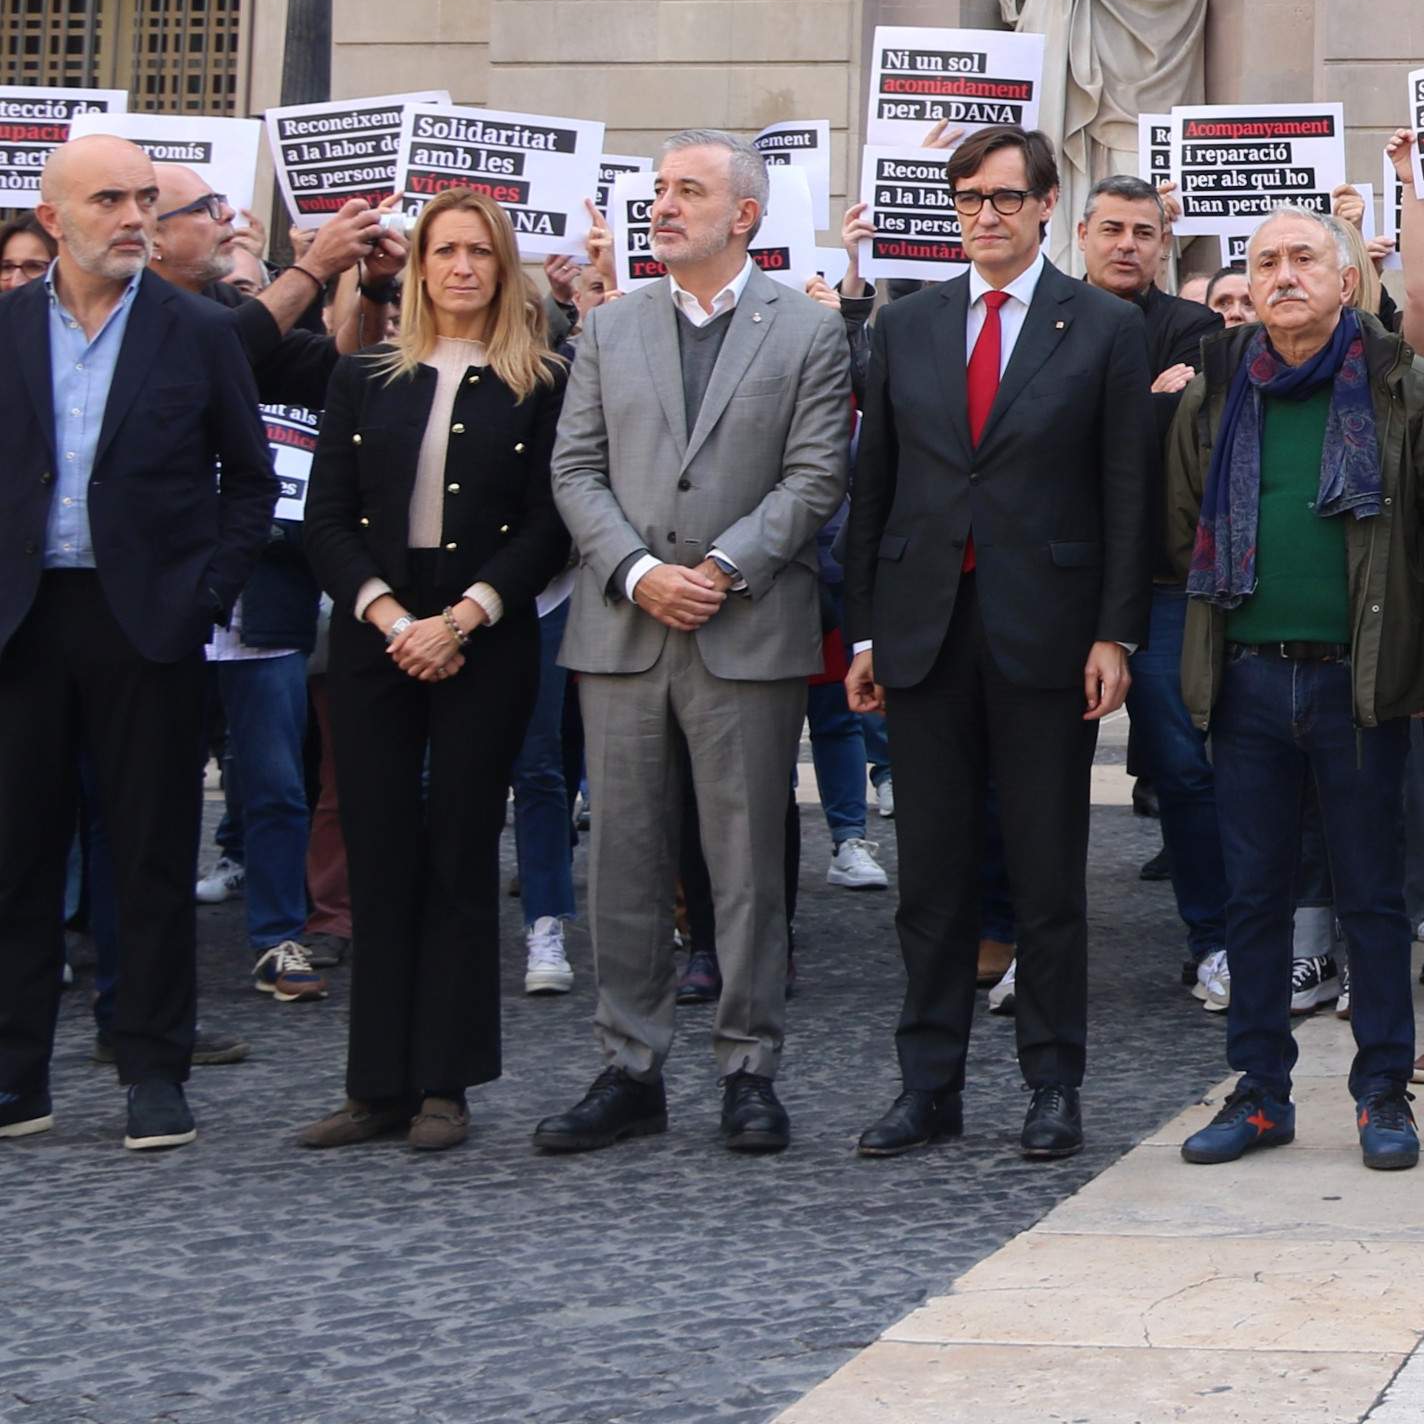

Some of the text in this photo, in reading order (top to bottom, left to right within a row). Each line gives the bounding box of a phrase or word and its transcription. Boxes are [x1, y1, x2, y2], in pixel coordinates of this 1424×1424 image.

[885, 50, 980, 73] Ni un sol
[883, 76, 1030, 100] acomiadament
[882, 101, 1015, 124] per la DANA
[417, 117, 558, 151] Solidaritat
[1184, 118, 1330, 139] Acompanyament
[287, 138, 378, 162] a la labor
[413, 145, 515, 174] amb les
[1185, 144, 1288, 167] i reparació
[291, 171, 318, 188] les
[1186, 167, 1309, 192] per als qui ho
[879, 187, 914, 204] a la
[1187, 195, 1324, 213] han tot
[878, 214, 905, 231] les
[289, 407, 318, 426] als
